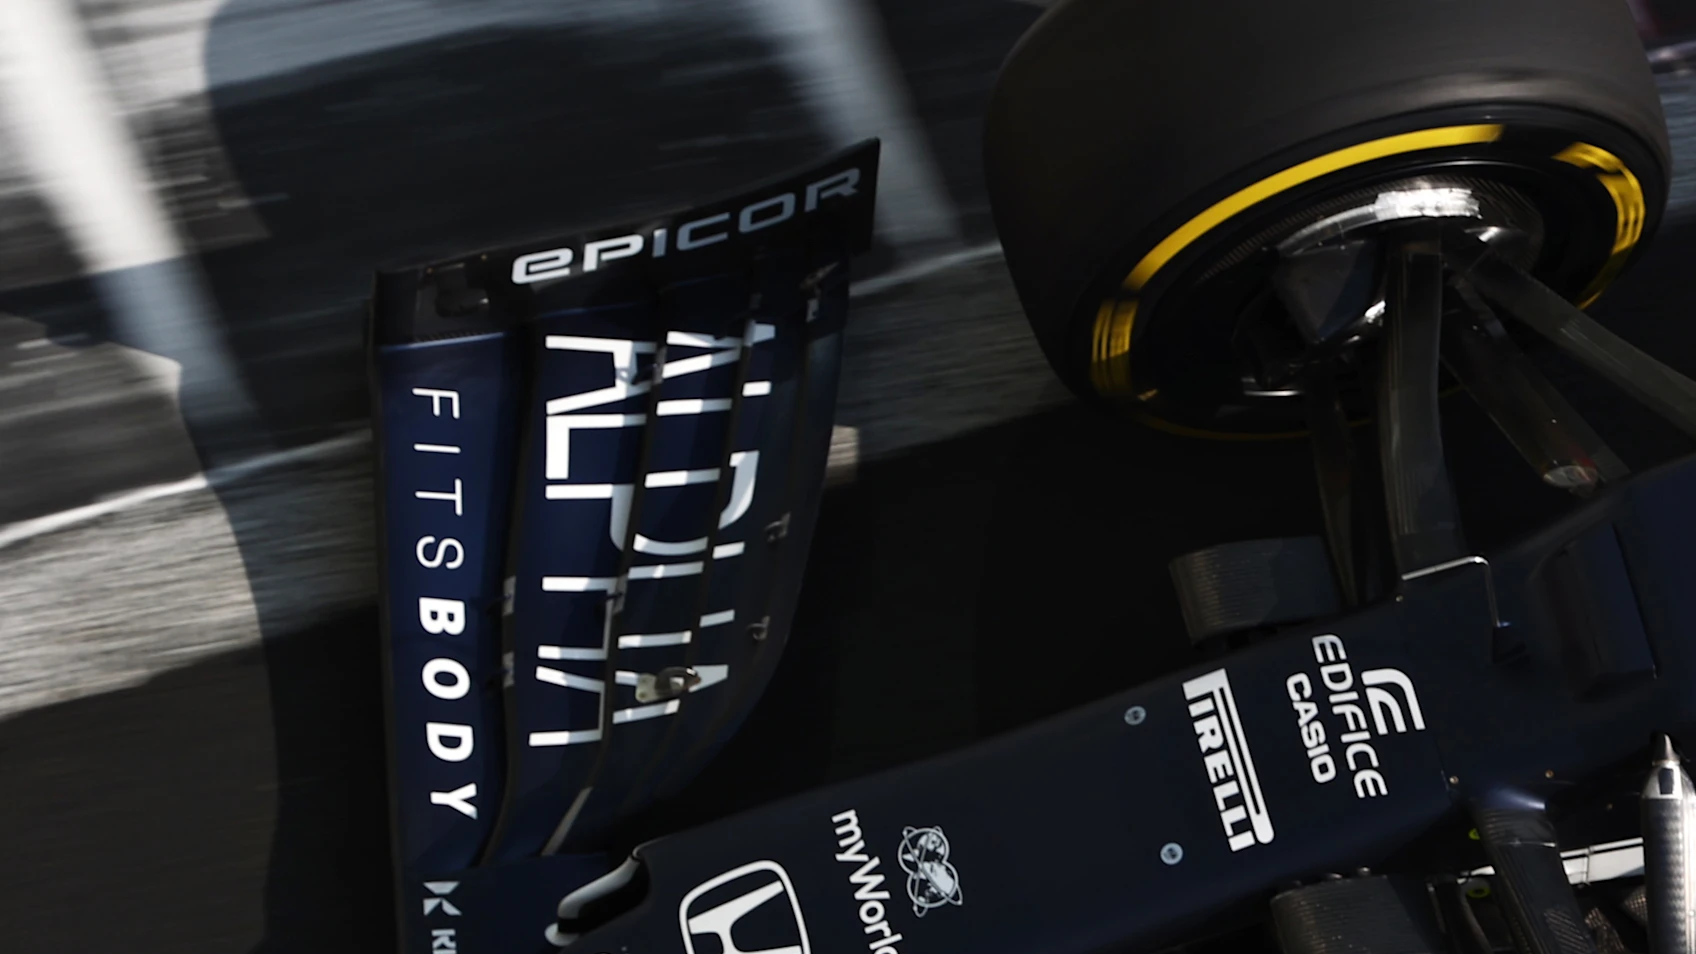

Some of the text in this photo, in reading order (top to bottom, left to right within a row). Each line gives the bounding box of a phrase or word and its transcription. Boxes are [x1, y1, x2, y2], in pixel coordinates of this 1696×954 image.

[411, 387, 478, 820] FITS BODY
[1182, 668, 1275, 852] PIRELLI
[1286, 673, 1337, 783] CASIO
[1312, 633, 1389, 798] EDIFICE
